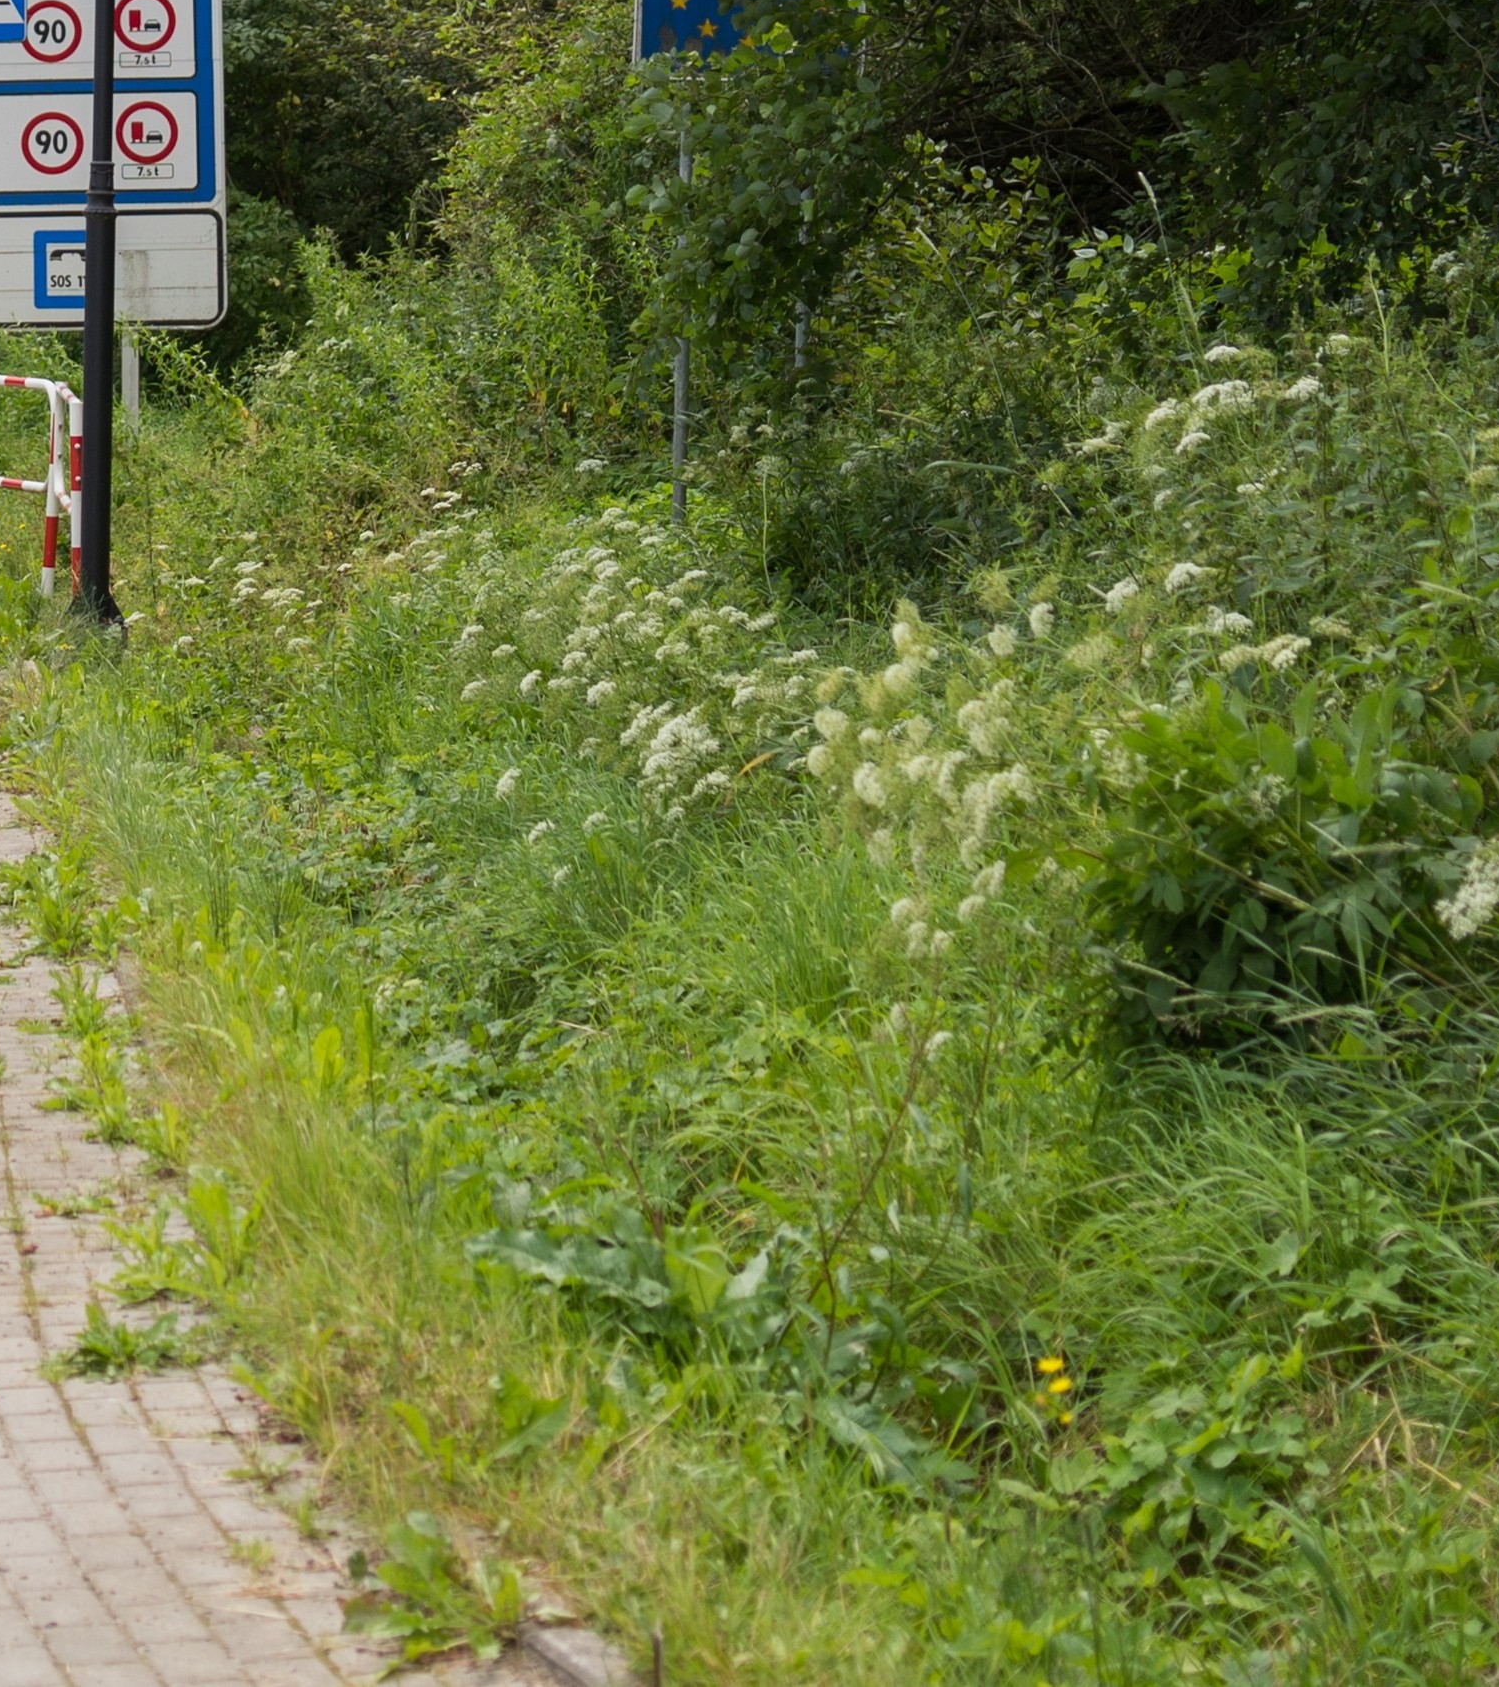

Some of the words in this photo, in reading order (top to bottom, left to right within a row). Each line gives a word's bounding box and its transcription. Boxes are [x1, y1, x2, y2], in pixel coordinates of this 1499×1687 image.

[33, 19, 67, 44] 90
[35, 130, 69, 155] 90
[50, 274, 72, 288] SOS
